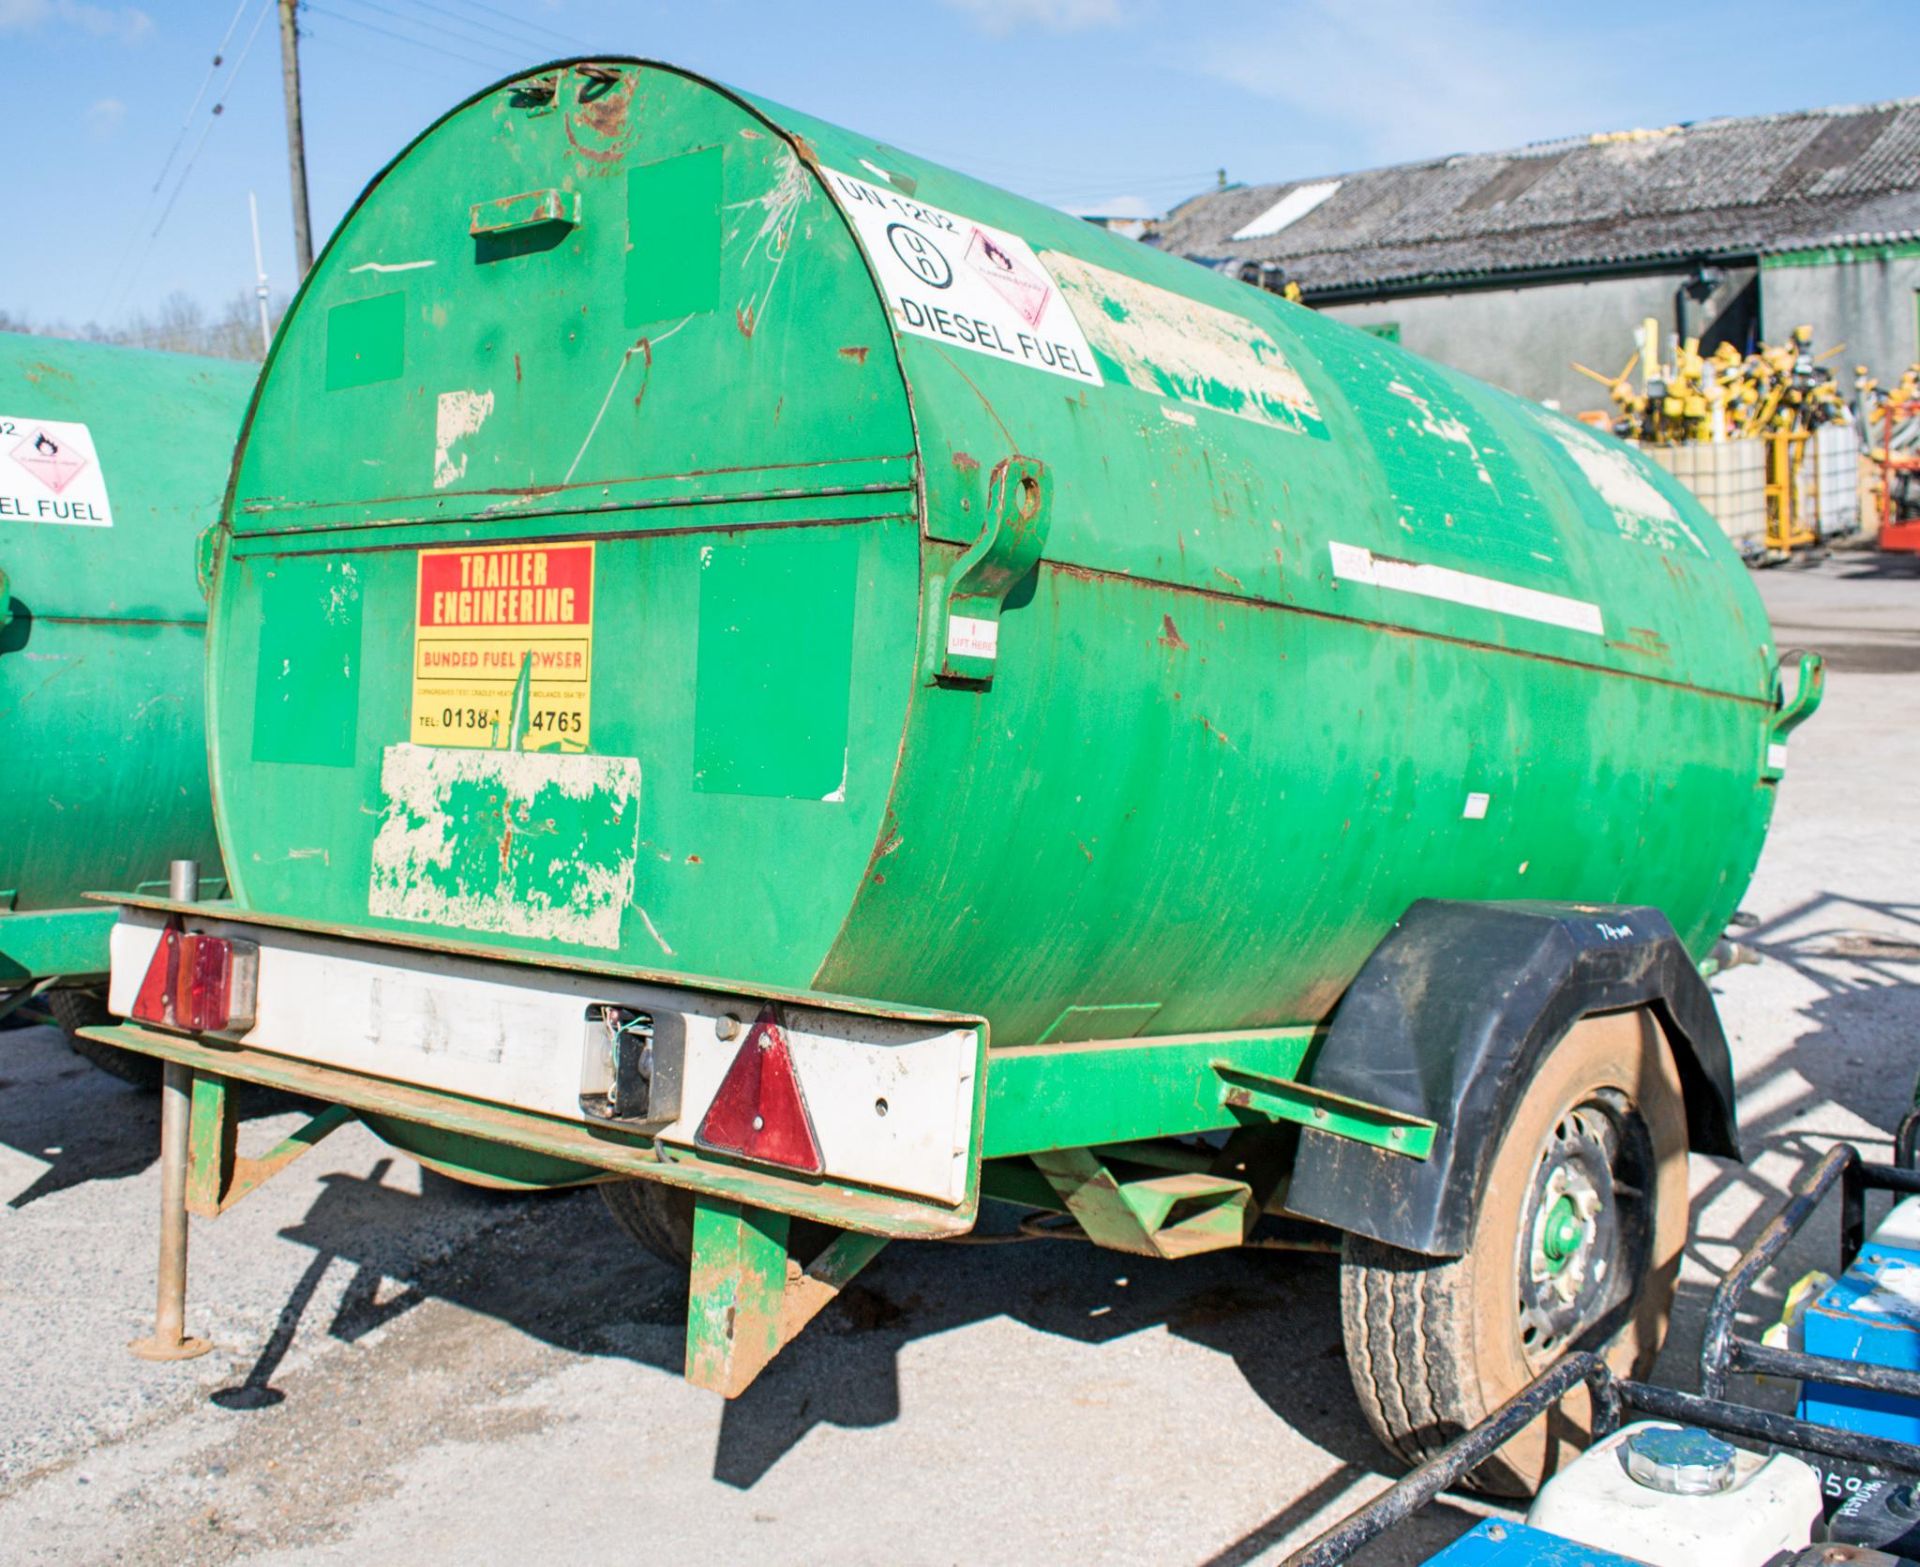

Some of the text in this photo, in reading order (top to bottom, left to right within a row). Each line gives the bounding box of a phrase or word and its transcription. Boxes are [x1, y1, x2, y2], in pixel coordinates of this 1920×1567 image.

[837, 177, 960, 235] UN 1202
[899, 297, 1093, 377] DIESEL FUEL
[38, 499, 103, 522] FUEL
[460, 552, 548, 588] TRAILER
[433, 588, 576, 624] ENGINEERING
[424, 652, 478, 667] BUNDED
[483, 653, 515, 667] FUEL
[419, 716, 440, 727] TEL:
